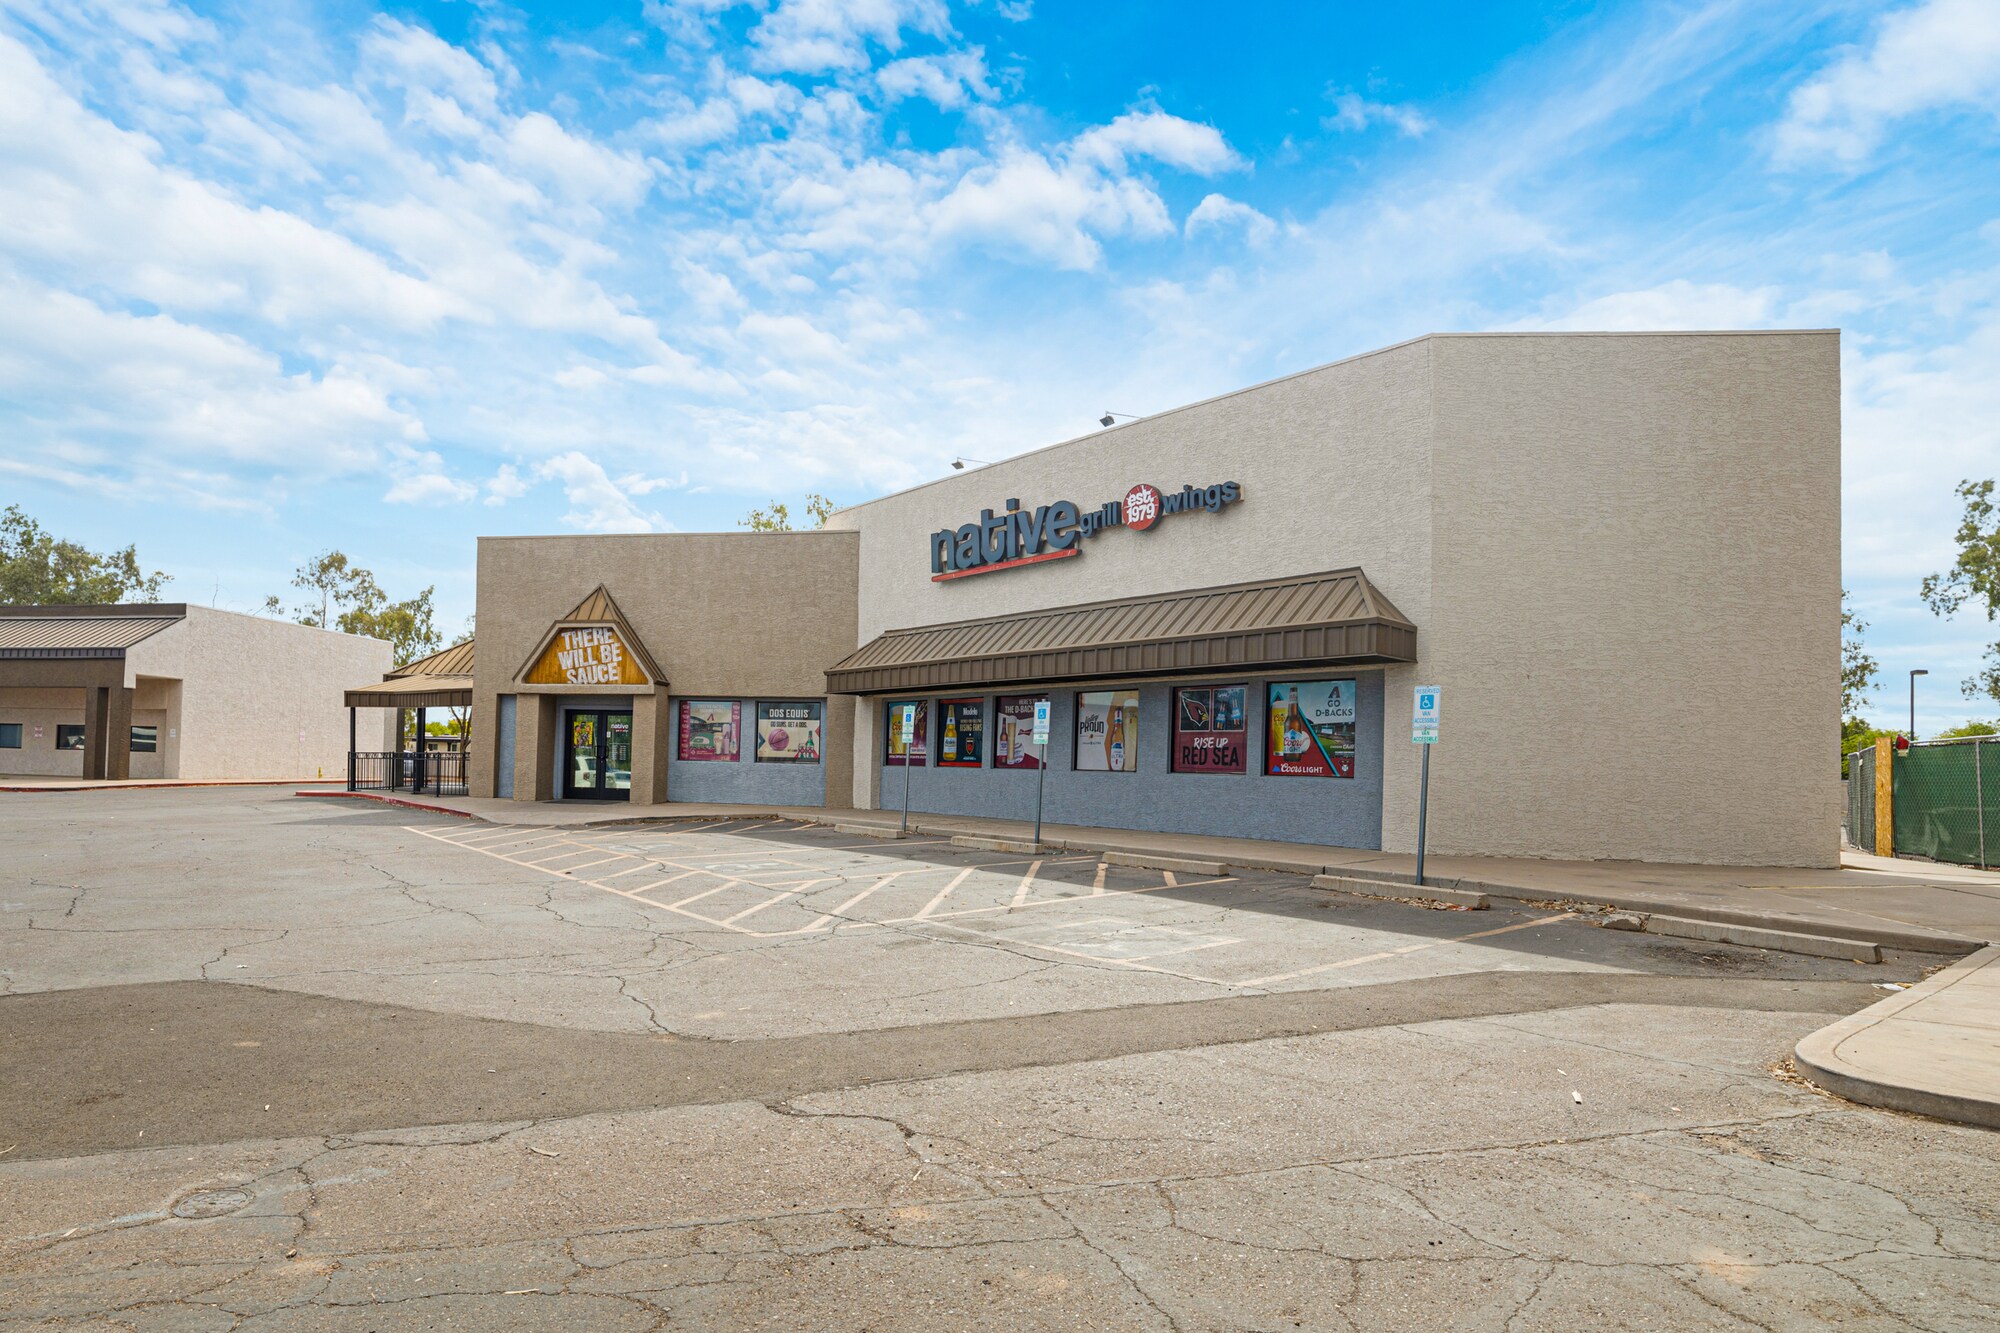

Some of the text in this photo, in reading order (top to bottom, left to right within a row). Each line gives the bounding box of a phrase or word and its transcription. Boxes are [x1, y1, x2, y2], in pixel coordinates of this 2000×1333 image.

[1163, 480, 1240, 514] wings
[1126, 504, 1156, 523] 1979
[931, 498, 1122, 573] native grill
[561, 627, 614, 650] THERE
[558, 643, 622, 670] WILL BE
[566, 662, 619, 684] SAUCE
[769, 709, 809, 718] DOS EQUIS
[1005, 705, 1015, 714] THE
[1015, 704, 1034, 713] D-BACK
[1315, 708, 1353, 717] D-BACKS
[1080, 721, 1104, 735] PROUD
[1193, 737, 1229, 750] RISE UP
[1284, 737, 1303, 747] Coors
[1182, 746, 1239, 766] RED SEA
[1280, 763, 1302, 773] Coors
